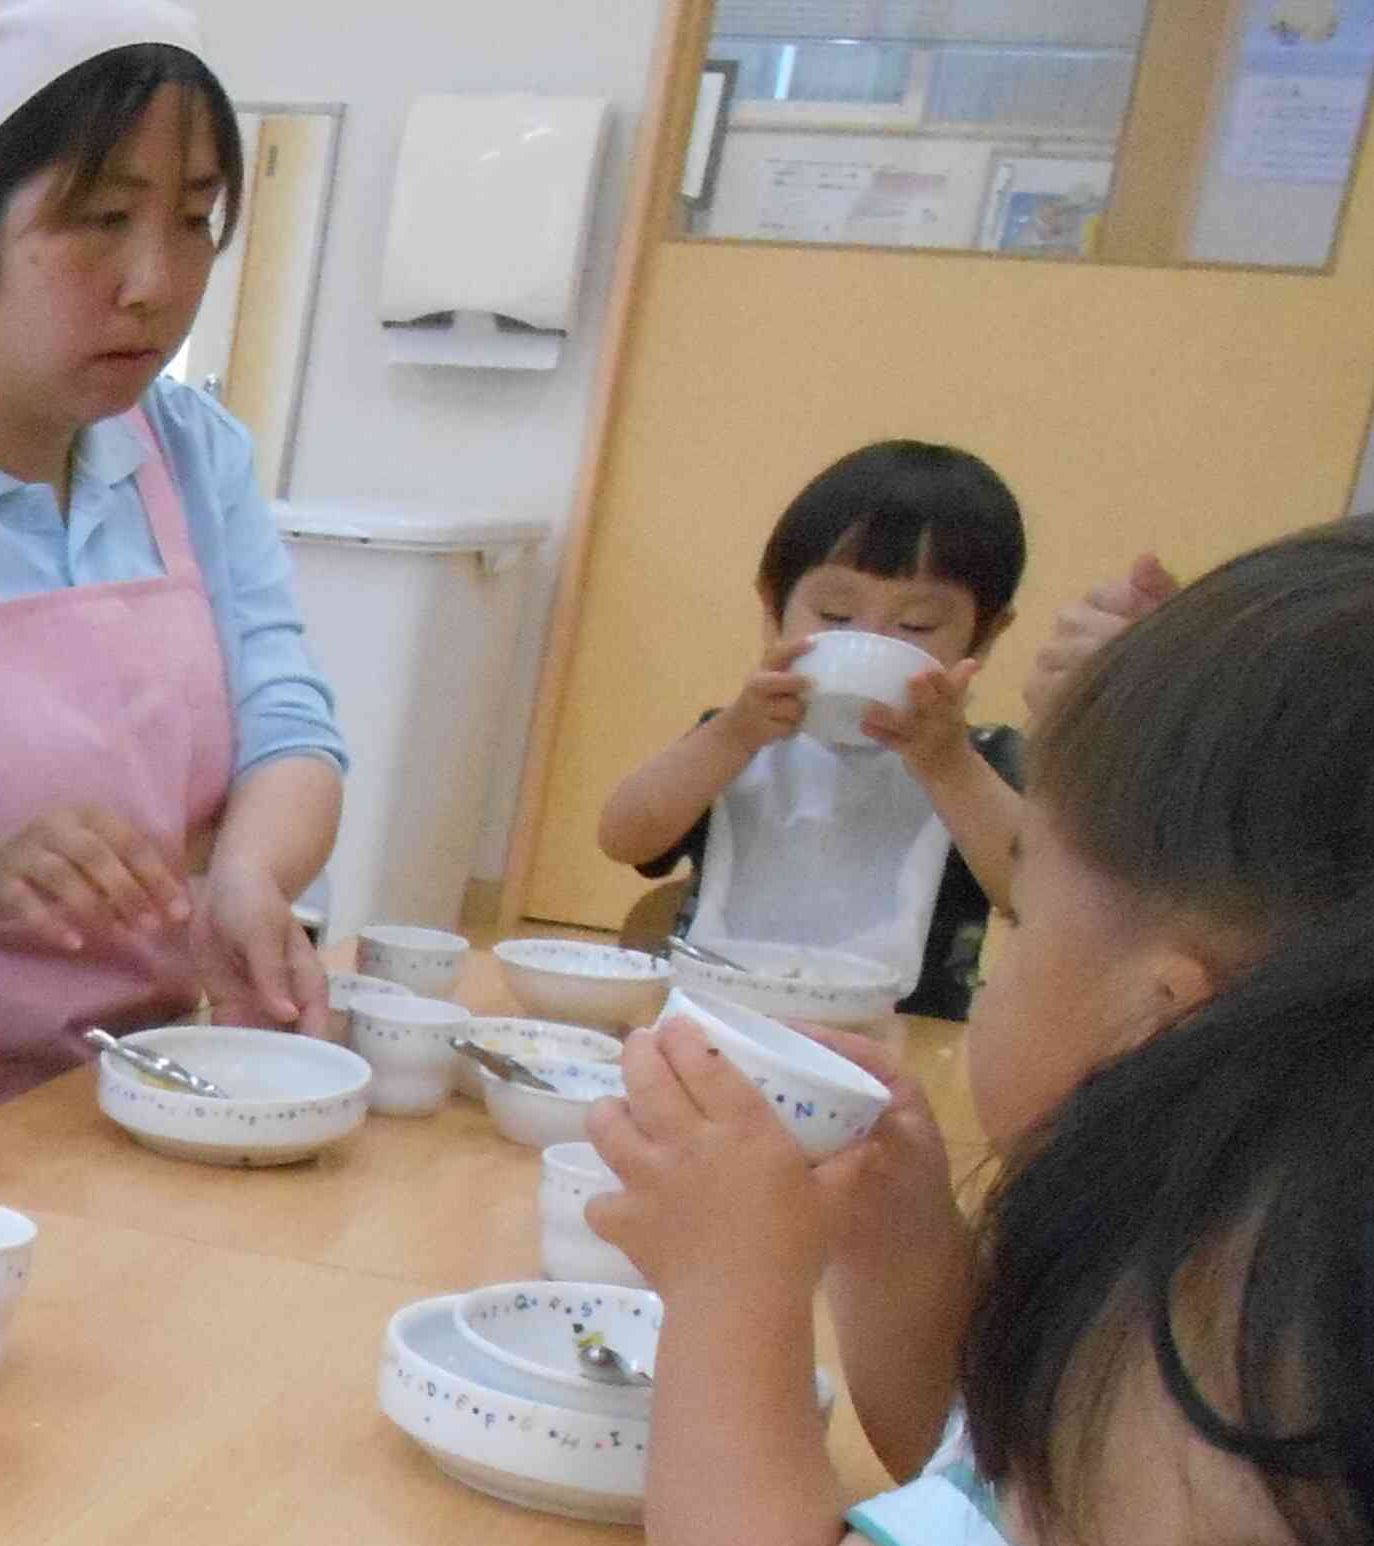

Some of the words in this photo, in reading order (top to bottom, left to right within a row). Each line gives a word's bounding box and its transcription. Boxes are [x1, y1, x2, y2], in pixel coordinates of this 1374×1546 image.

[795, 1102, 813, 1118] N
[514, 1294, 529, 1310] Q
[581, 1301, 593, 1318] S
